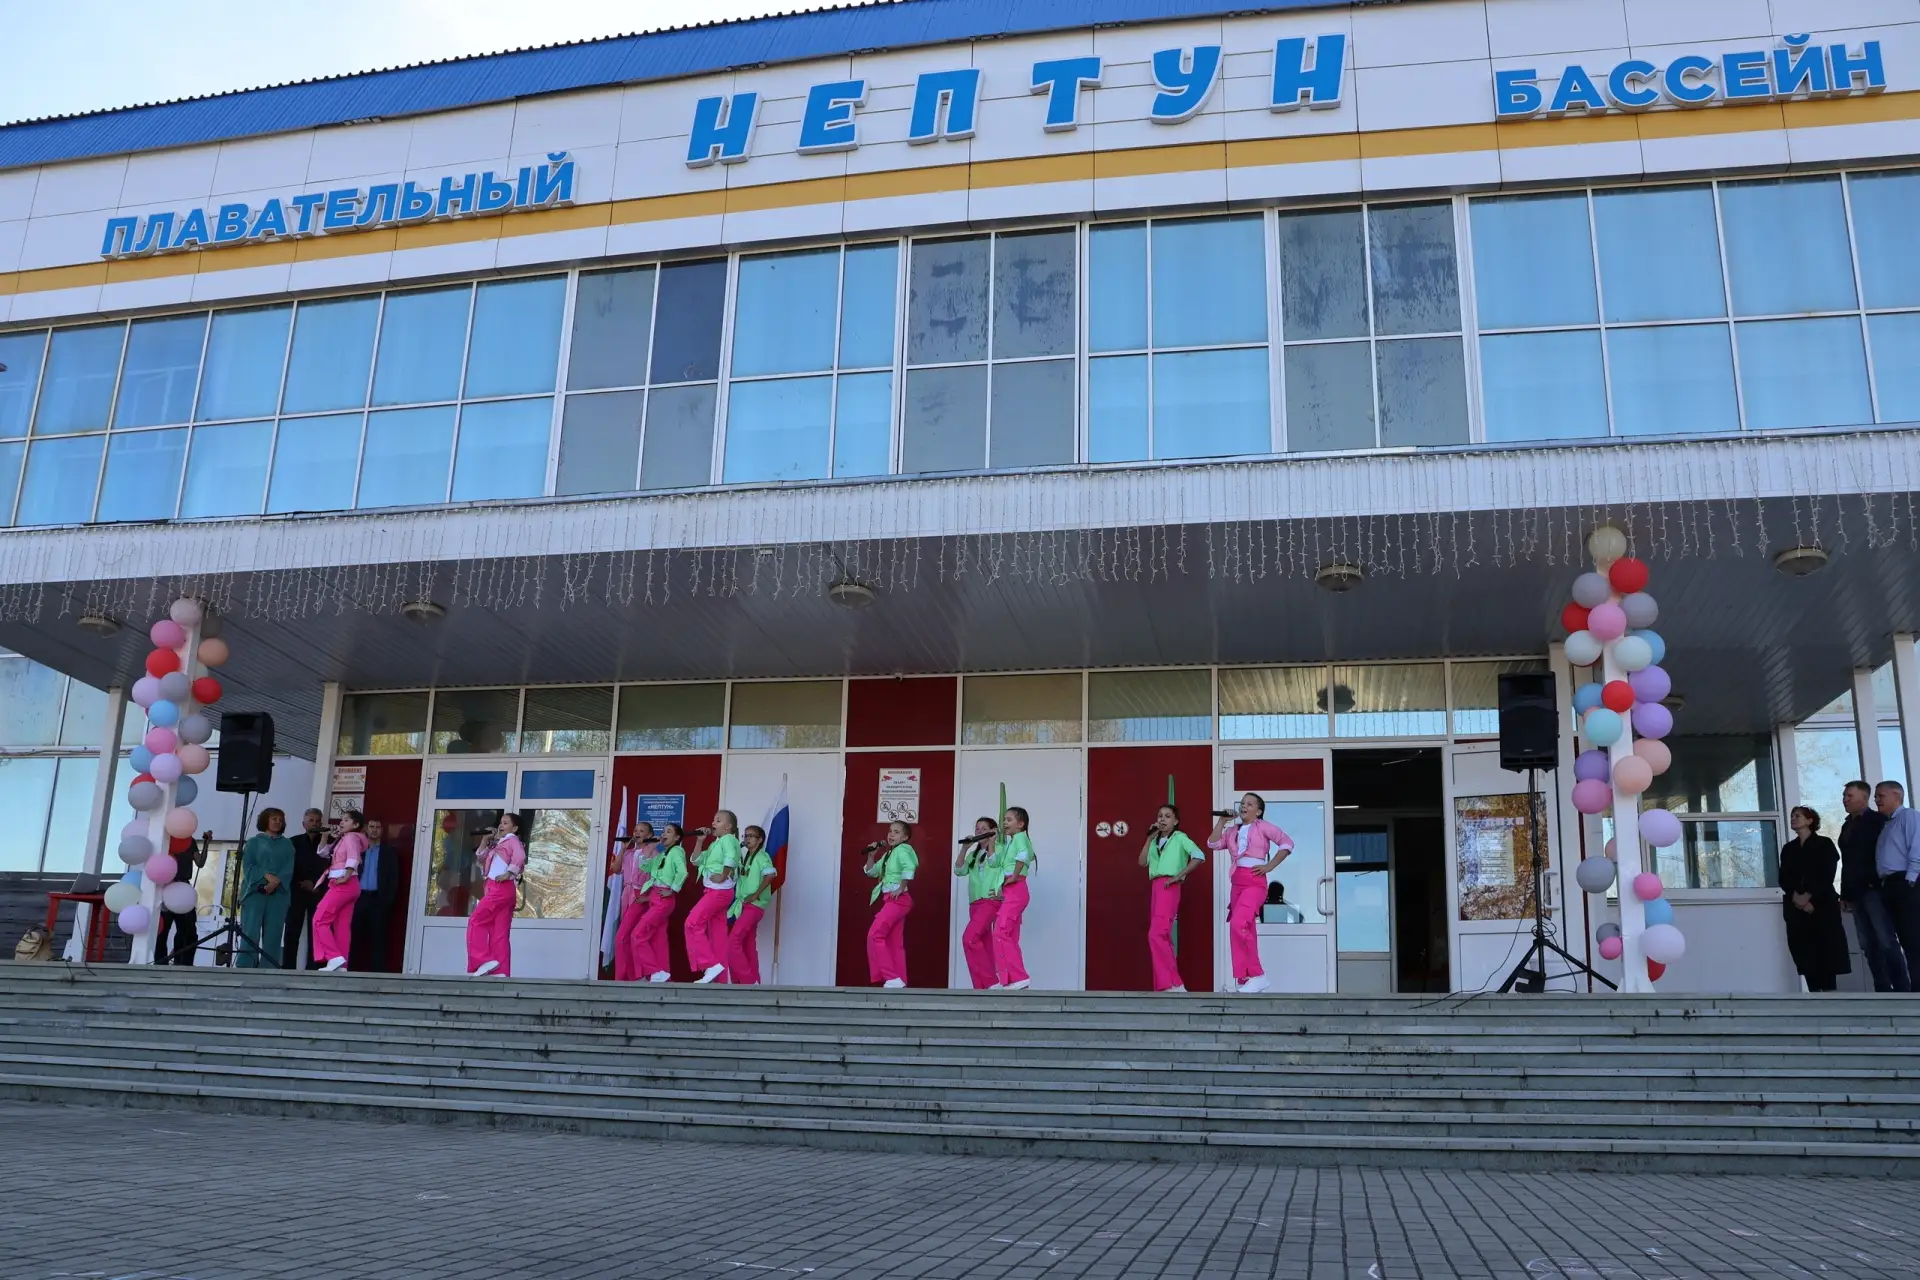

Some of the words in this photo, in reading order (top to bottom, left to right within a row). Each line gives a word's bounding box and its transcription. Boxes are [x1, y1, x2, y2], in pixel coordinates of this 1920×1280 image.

[687, 34, 1347, 167] НЕПТУН
[1495, 33, 1886, 117] БАССЕЙН
[101, 152, 577, 257] ПЛАВАТЕЛЬНЫЙ
